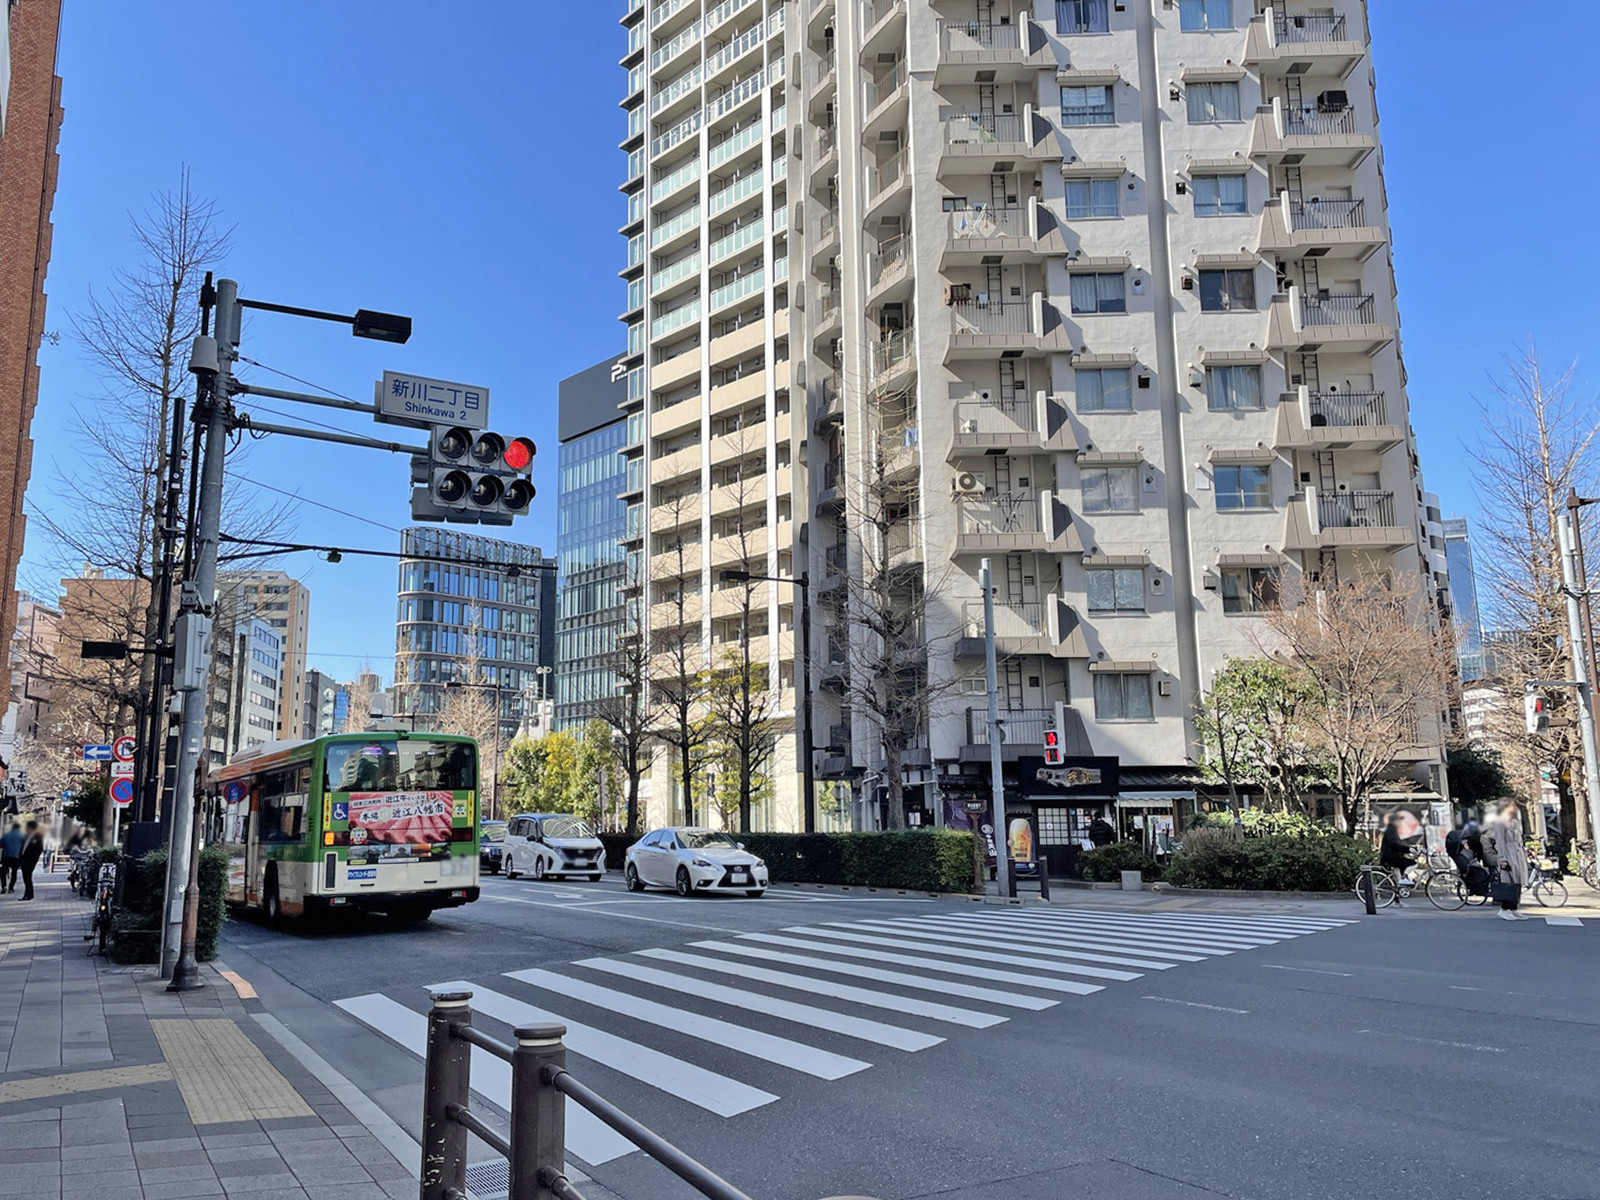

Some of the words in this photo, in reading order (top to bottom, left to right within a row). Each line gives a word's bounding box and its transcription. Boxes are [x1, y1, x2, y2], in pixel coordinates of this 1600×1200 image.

[391, 378, 480, 410] 新川二丁目
[404, 401, 455, 419] Shinkawa
[459, 410, 467, 421] 2
[391, 803, 444, 819] 近江八幡市
